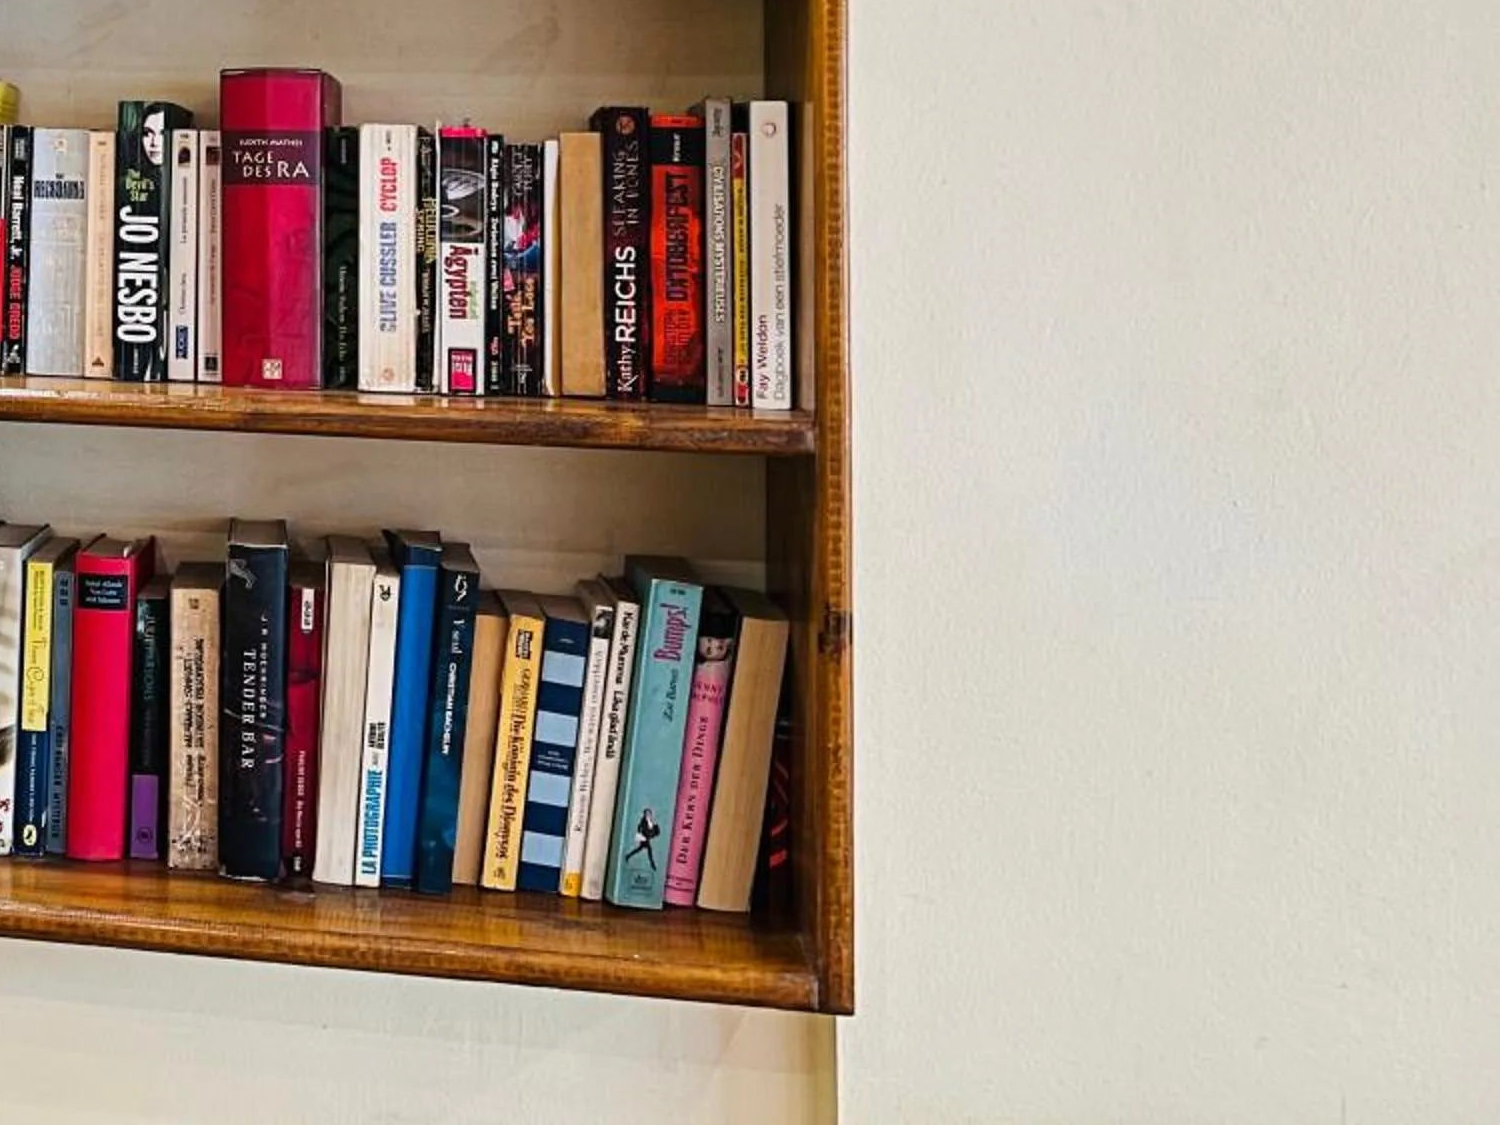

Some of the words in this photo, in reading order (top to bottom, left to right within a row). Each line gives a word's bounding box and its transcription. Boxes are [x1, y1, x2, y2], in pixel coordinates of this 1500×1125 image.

[233, 151, 274, 164] TAGE
[243, 166, 271, 178] DES
[277, 161, 310, 178] RA
[625, 141, 639, 197] BONES
[13, 175, 25, 199] Neal
[379, 158, 397, 212] CYCLOP
[613, 151, 626, 236] SPEAKING
[714, 166, 724, 241] CIVILISATIONS
[119, 206, 159, 244] JO
[625, 203, 639, 224] IN
[379, 222, 397, 287] CUSSLER
[665, 173, 688, 302] OKTOBERFEST
[773, 204, 784, 282] stiefmoeder
[10, 265, 21, 299] JUDGE
[116, 252, 158, 342] NESBO
[445, 245, 478, 319] Ägypten
[614, 247, 636, 342] REICHS
[775, 286, 784, 309] een
[10, 301, 21, 339] DREDD
[380, 290, 398, 332] CLIVE
[775, 313, 784, 337] van
[756, 315, 767, 368] Weldon
[617, 344, 639, 392] Kathy
[756, 374, 768, 399] Fay
[773, 342, 787, 401] Dagboek
[653, 604, 691, 663] Bumps!
[615, 643, 629, 684] Mumma
[242, 650, 256, 723] TENDER
[606, 713, 621, 733] glad
[692, 716, 709, 758] DINGE
[242, 731, 256, 768] BAR
[689, 765, 701, 789] DER
[362, 771, 382, 858] PHOTOGRAPHIE
[680, 795, 696, 830] KERN
[361, 862, 376, 875] LA
[676, 835, 690, 864] DER
